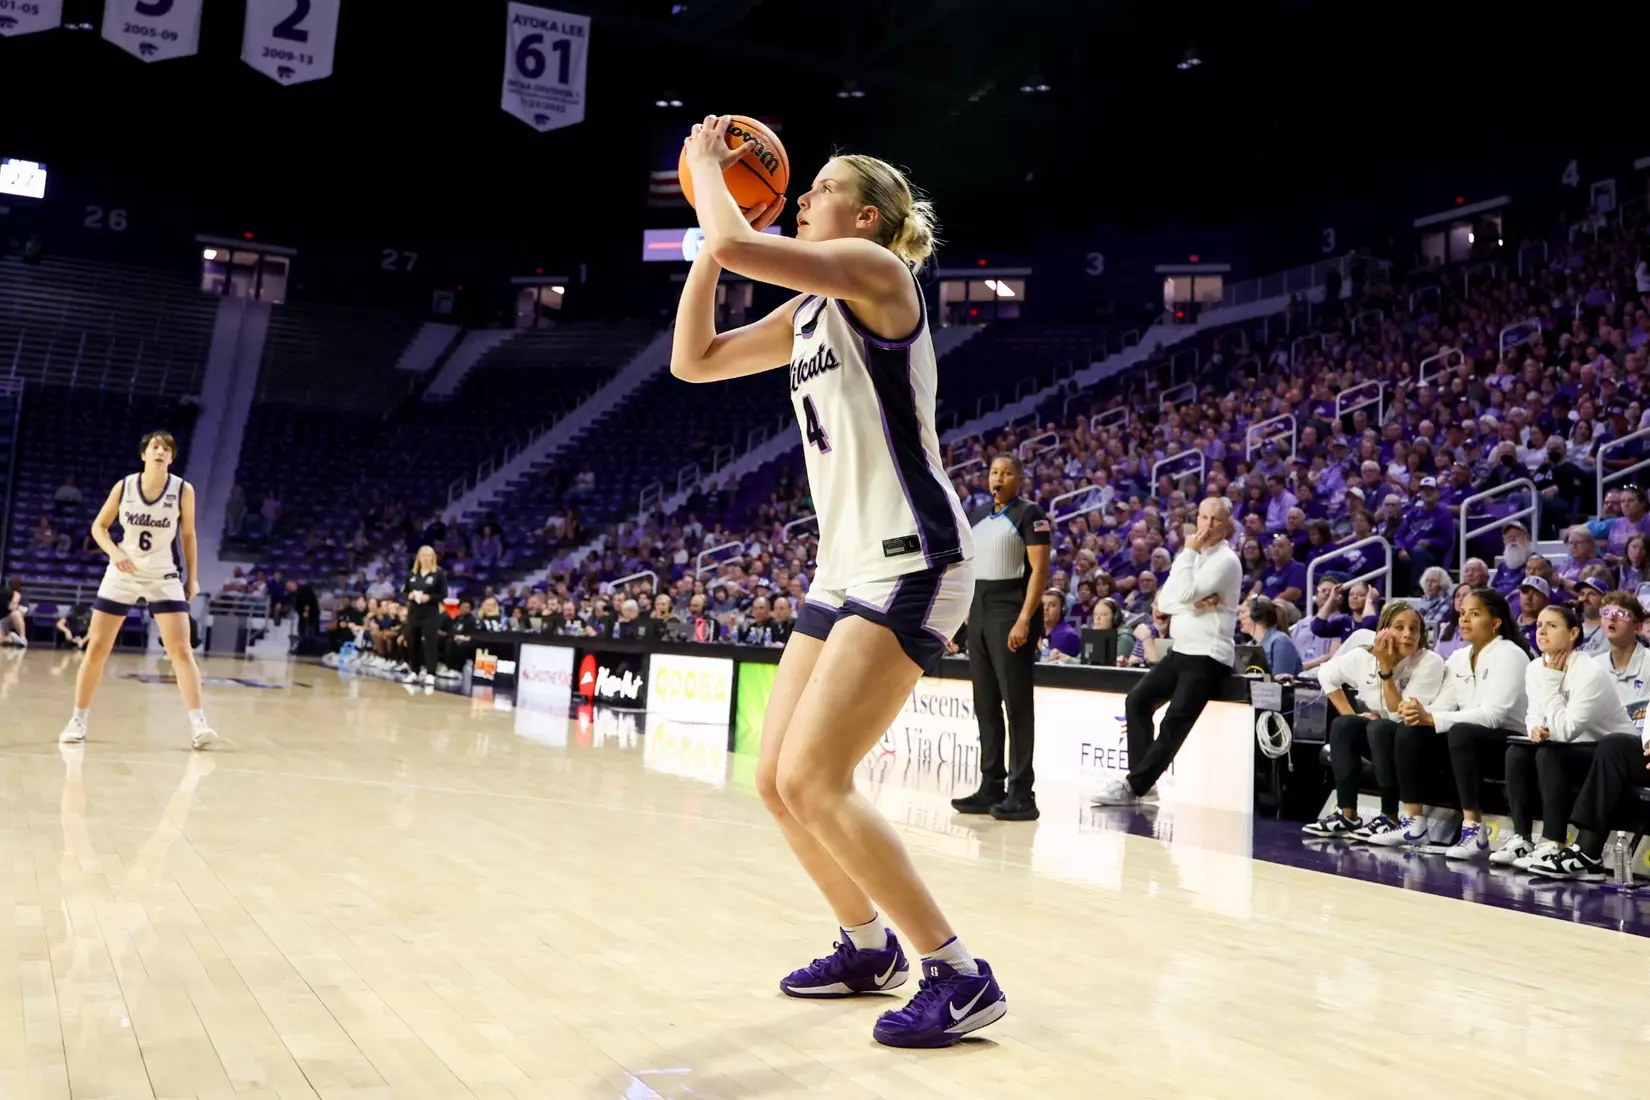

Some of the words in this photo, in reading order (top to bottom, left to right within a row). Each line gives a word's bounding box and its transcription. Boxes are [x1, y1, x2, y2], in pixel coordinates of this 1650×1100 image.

[122, 22, 179, 42] 2005-09
[512, 14, 559, 33] AYOKA
[561, 22, 585, 38] LEE
[262, 46, 314, 65] 2009-13
[516, 33, 572, 85] 61
[1562, 160, 1580, 187] 4
[83, 205, 128, 231] 26
[1322, 228, 1336, 253] 3
[381, 249, 419, 272] 27
[1086, 252, 1104, 276] 3
[802, 393, 832, 455] 4
[125, 511, 171, 528] Wildcats
[139, 530, 152, 551] 6
[656, 666, 727, 705] QDOBA
[905, 687, 976, 721] Ascens
[905, 727, 932, 758] Via
